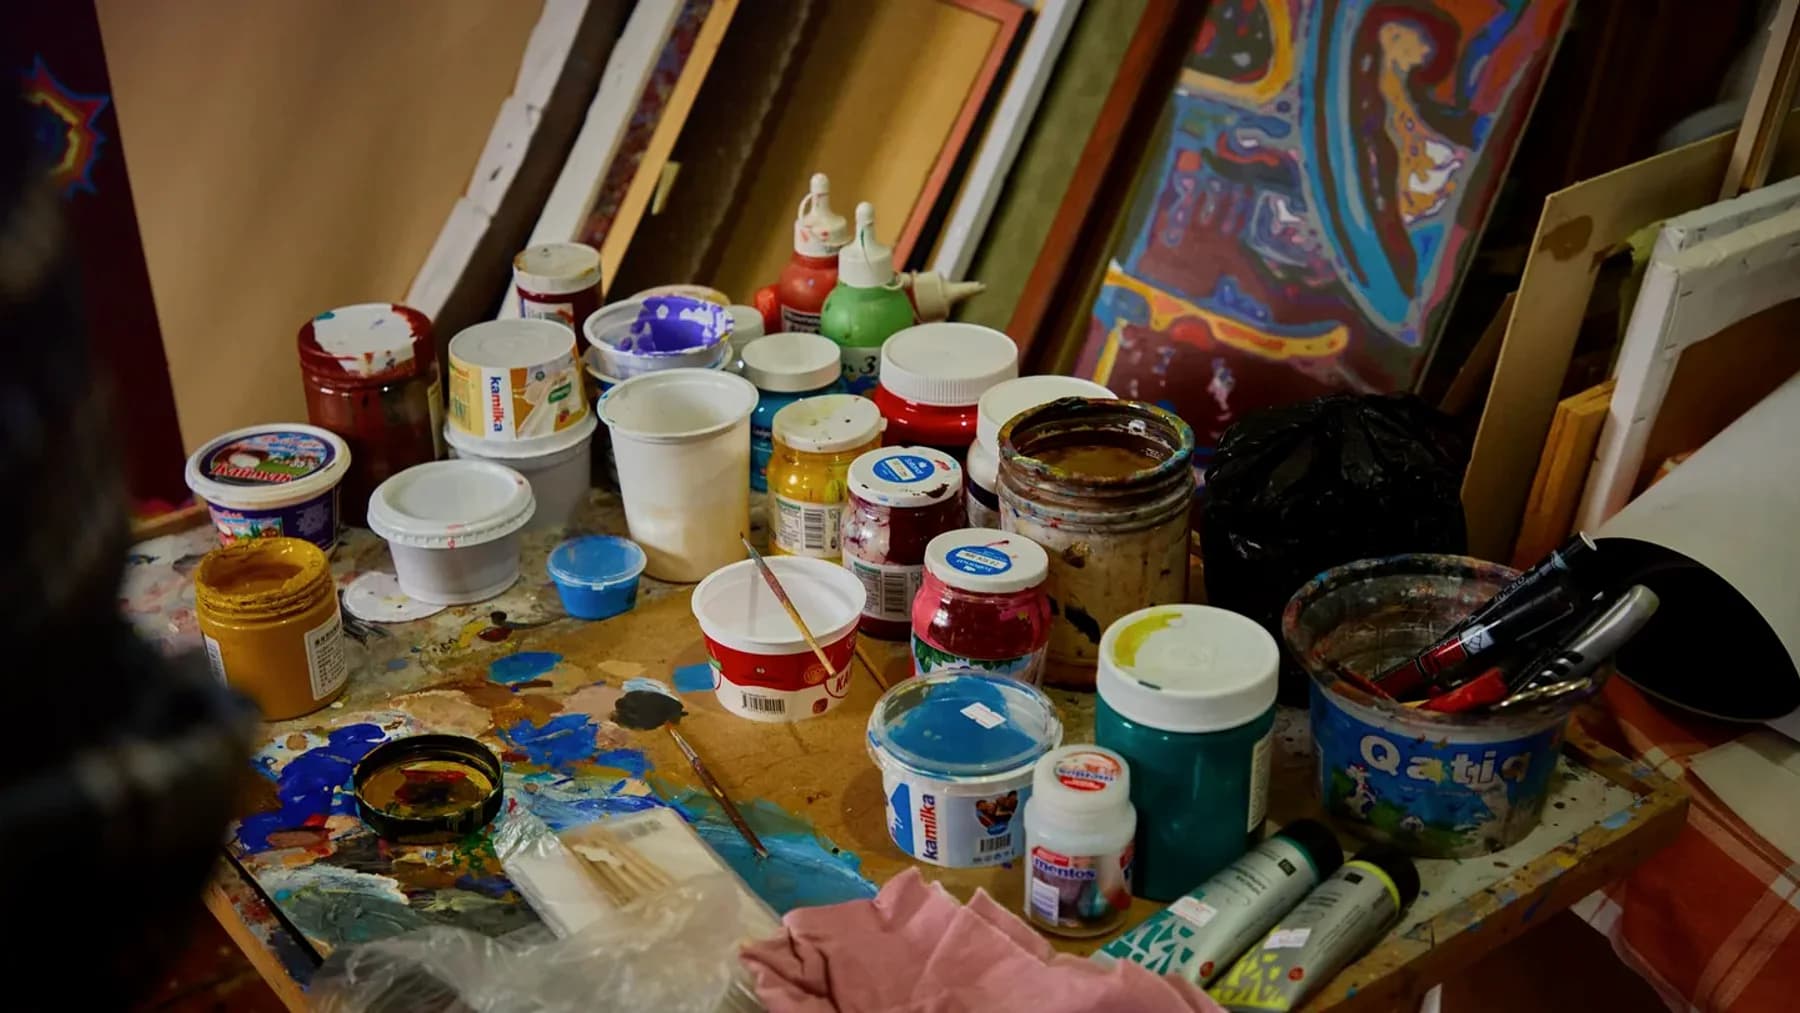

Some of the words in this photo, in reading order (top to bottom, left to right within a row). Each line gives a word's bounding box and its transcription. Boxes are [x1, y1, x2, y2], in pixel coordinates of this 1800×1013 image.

[490, 376, 505, 432] kamilka
[1360, 735, 1532, 783] Qatiq
[919, 793, 939, 861] kamilka
[1033, 856, 1097, 882] mentos
